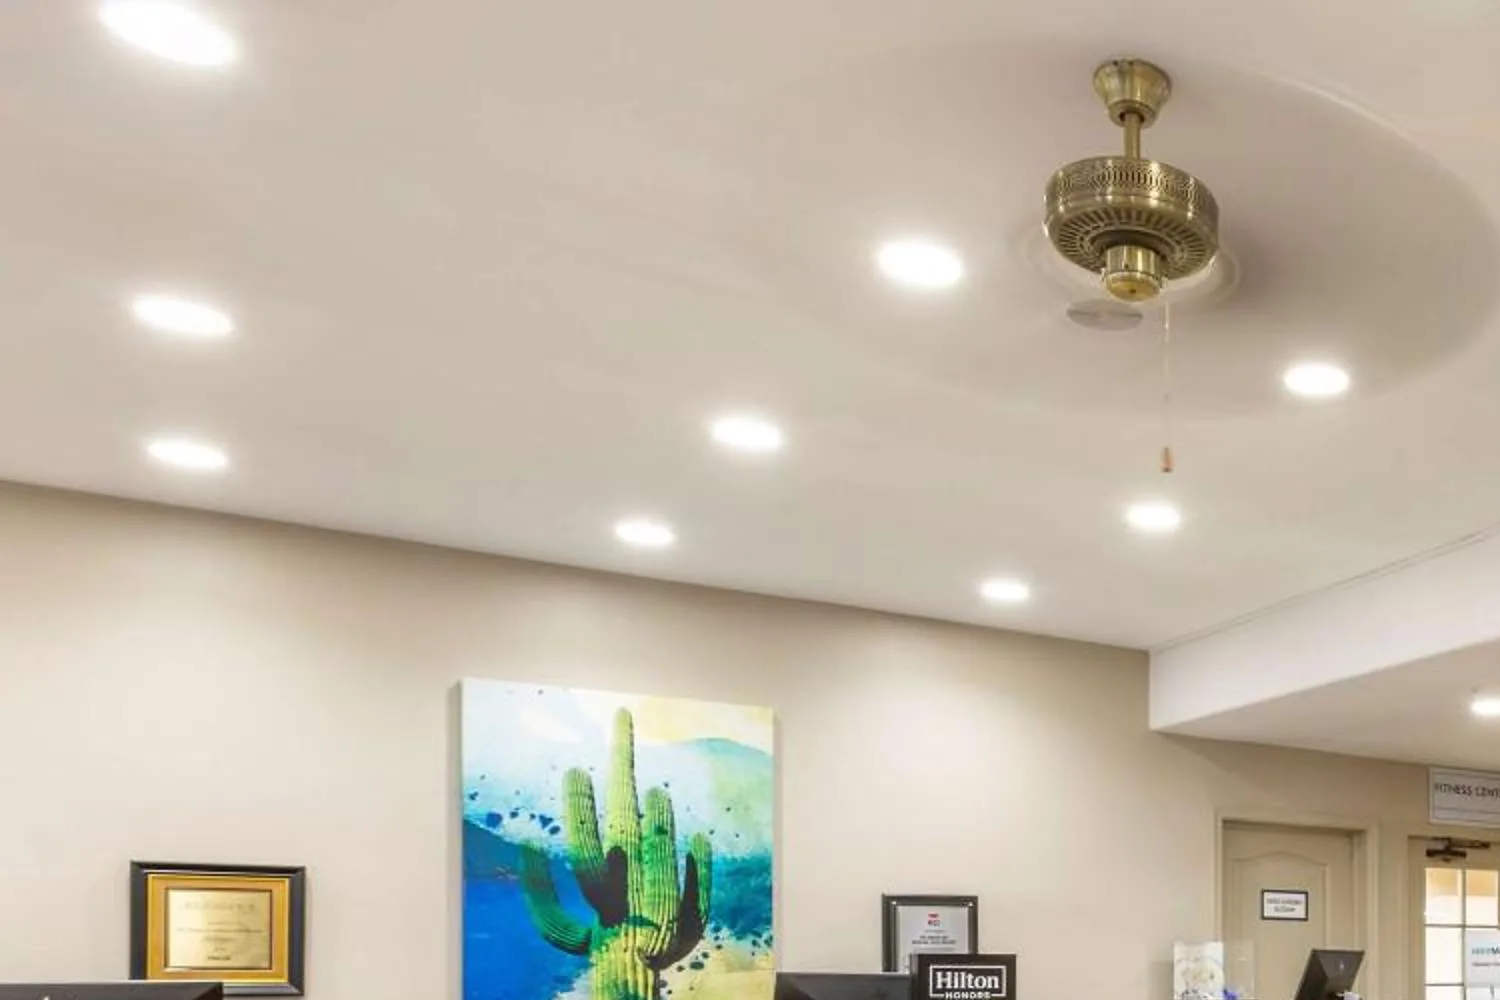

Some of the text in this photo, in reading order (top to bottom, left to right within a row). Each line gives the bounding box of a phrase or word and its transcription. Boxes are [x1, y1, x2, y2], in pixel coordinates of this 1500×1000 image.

[1434, 783, 1473, 797] FITNESS
[935, 971, 1000, 990] Hilton
[945, 991, 992, 1000] HONORS
